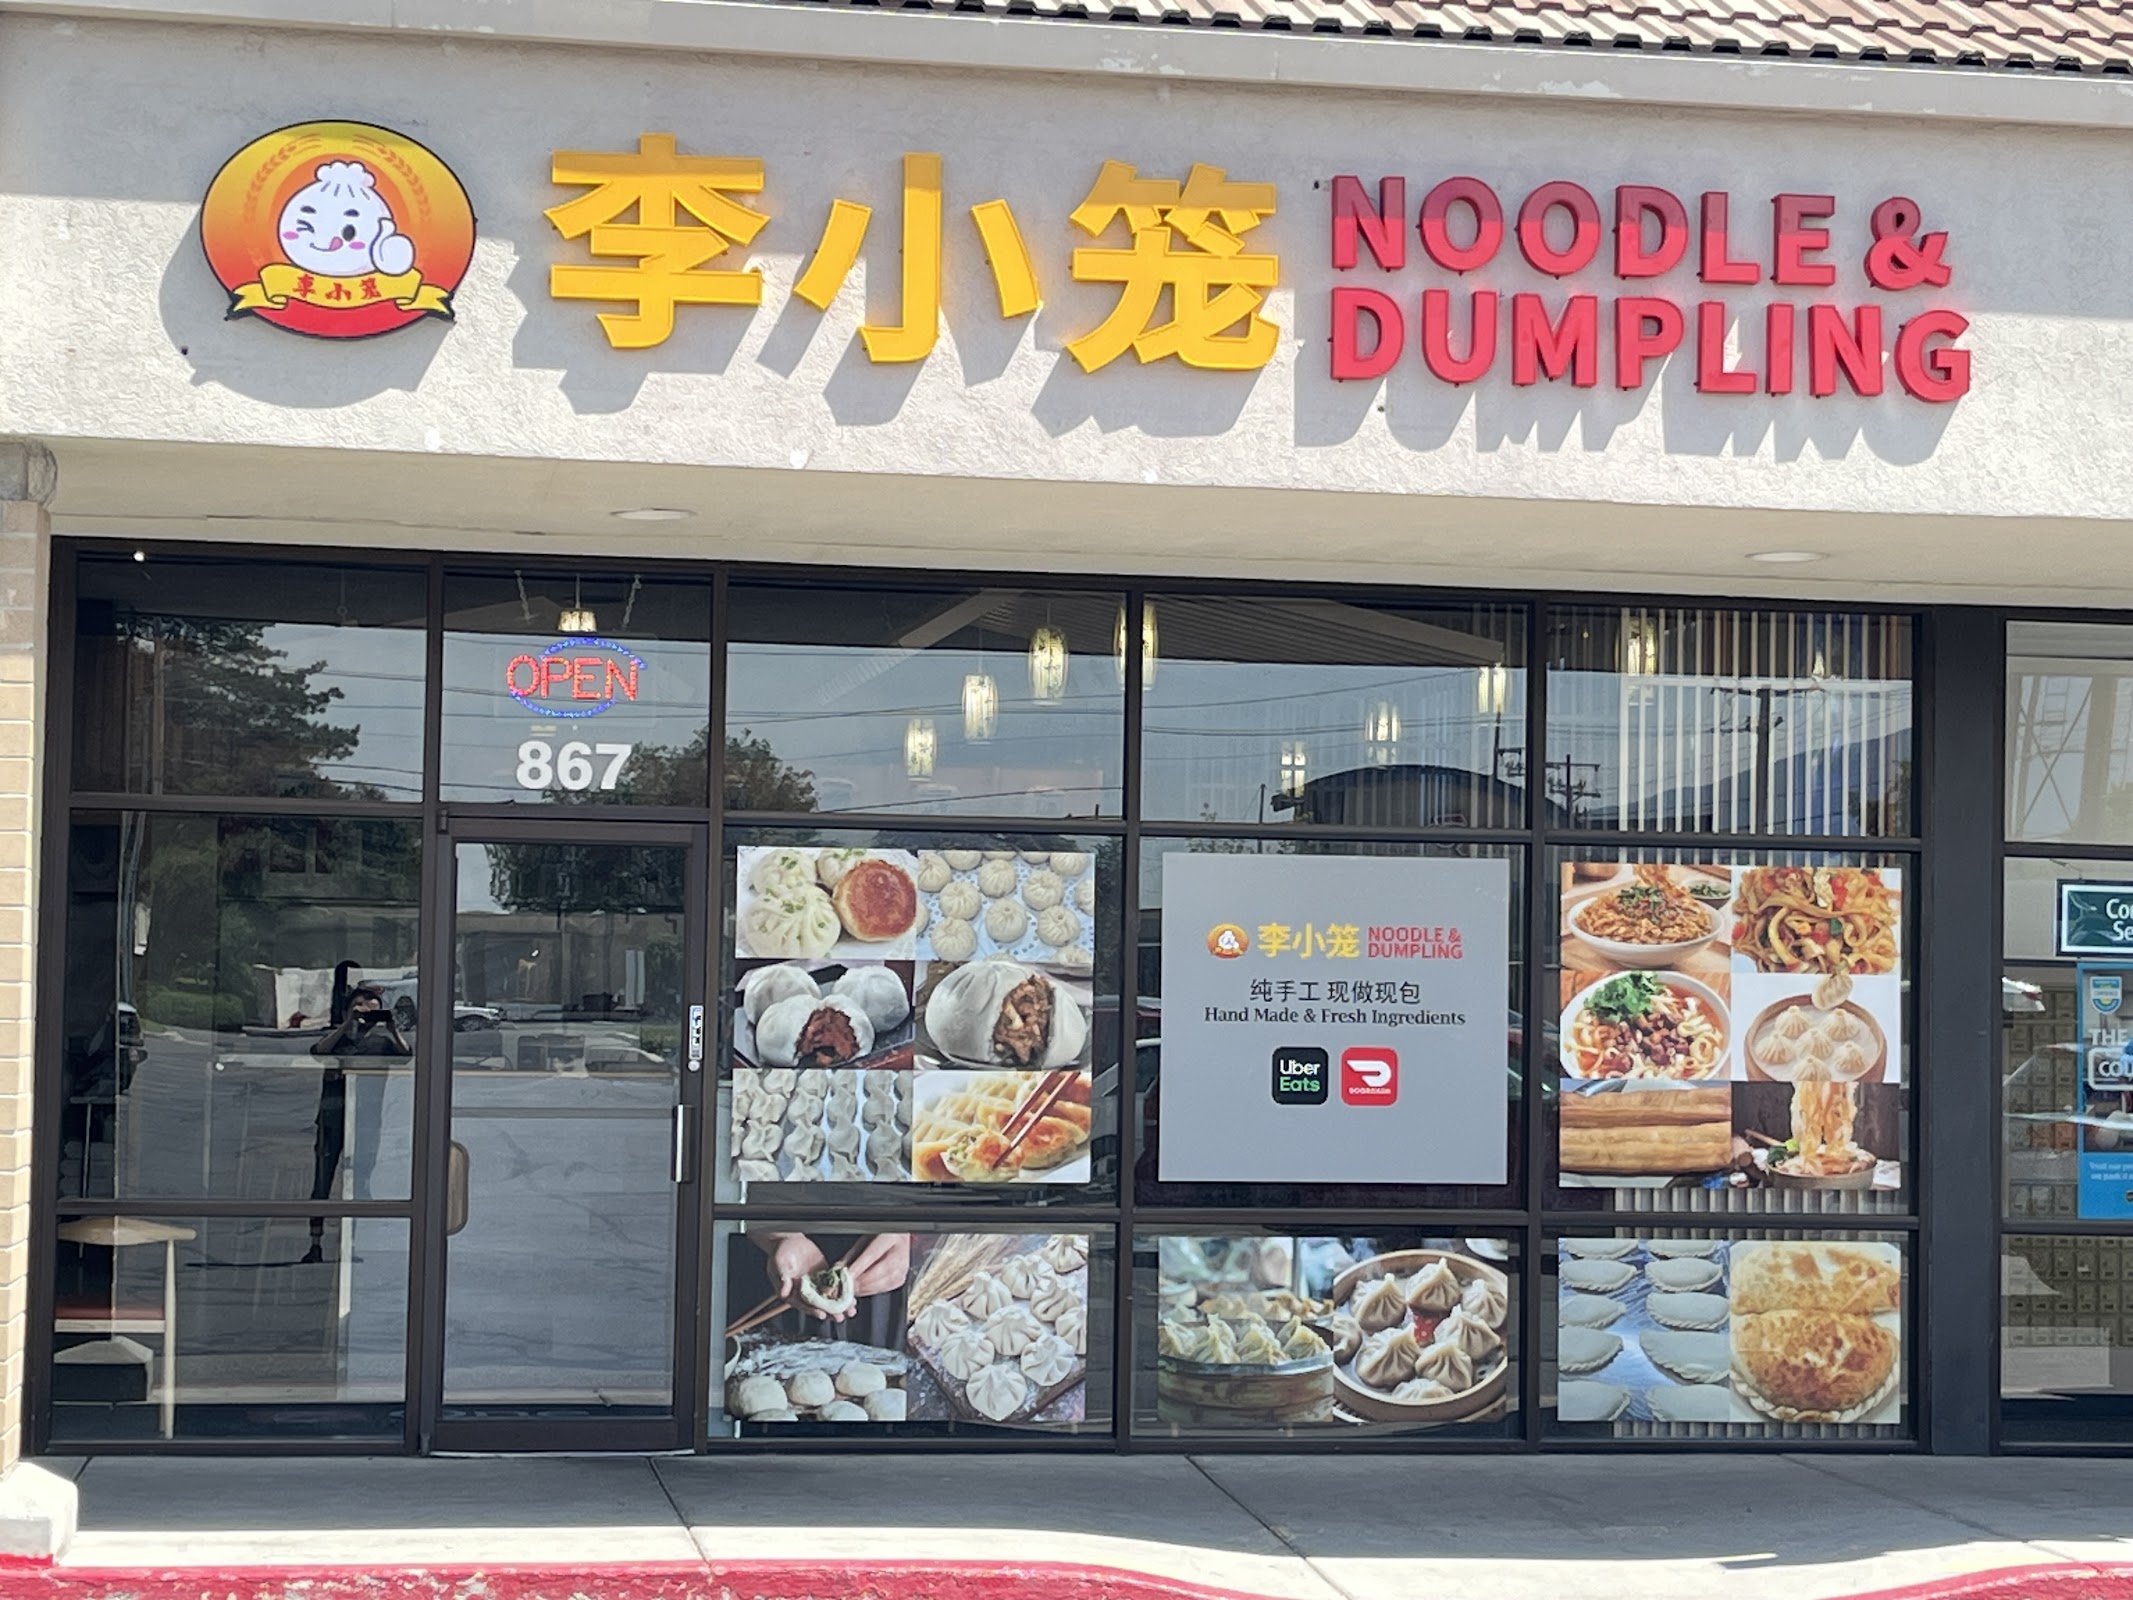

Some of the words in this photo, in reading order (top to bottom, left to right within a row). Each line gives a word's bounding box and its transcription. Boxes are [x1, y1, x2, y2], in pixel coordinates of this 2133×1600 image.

[1331, 175, 1837, 286] NOODLE
[1863, 196, 1952, 292] &
[543, 131, 1281, 373] 李小笼
[1330, 286, 1972, 404] DUMPLING
[506, 654, 637, 701] OPEN
[515, 740, 633, 791] 867
[1257, 923, 1360, 958] 李小笼
[1368, 926, 1444, 942] NOODLE
[1448, 928, 1462, 942] &
[1368, 943, 1463, 959] DUMPLING
[1249, 979, 1322, 1003] 纯手工
[1327, 980, 1421, 1004] 现做现包
[1204, 1007, 1248, 1023] Hand
[1254, 1008, 1299, 1024] Made
[1303, 1009, 1316, 1024] &
[1321, 1009, 1367, 1025] Fresh
[1372, 1010, 1466, 1028] Ingredients
[2088, 1028, 2128, 1047] THE
[1279, 1059, 1321, 1076] Uber
[1279, 1076, 1321, 1093] Eats
